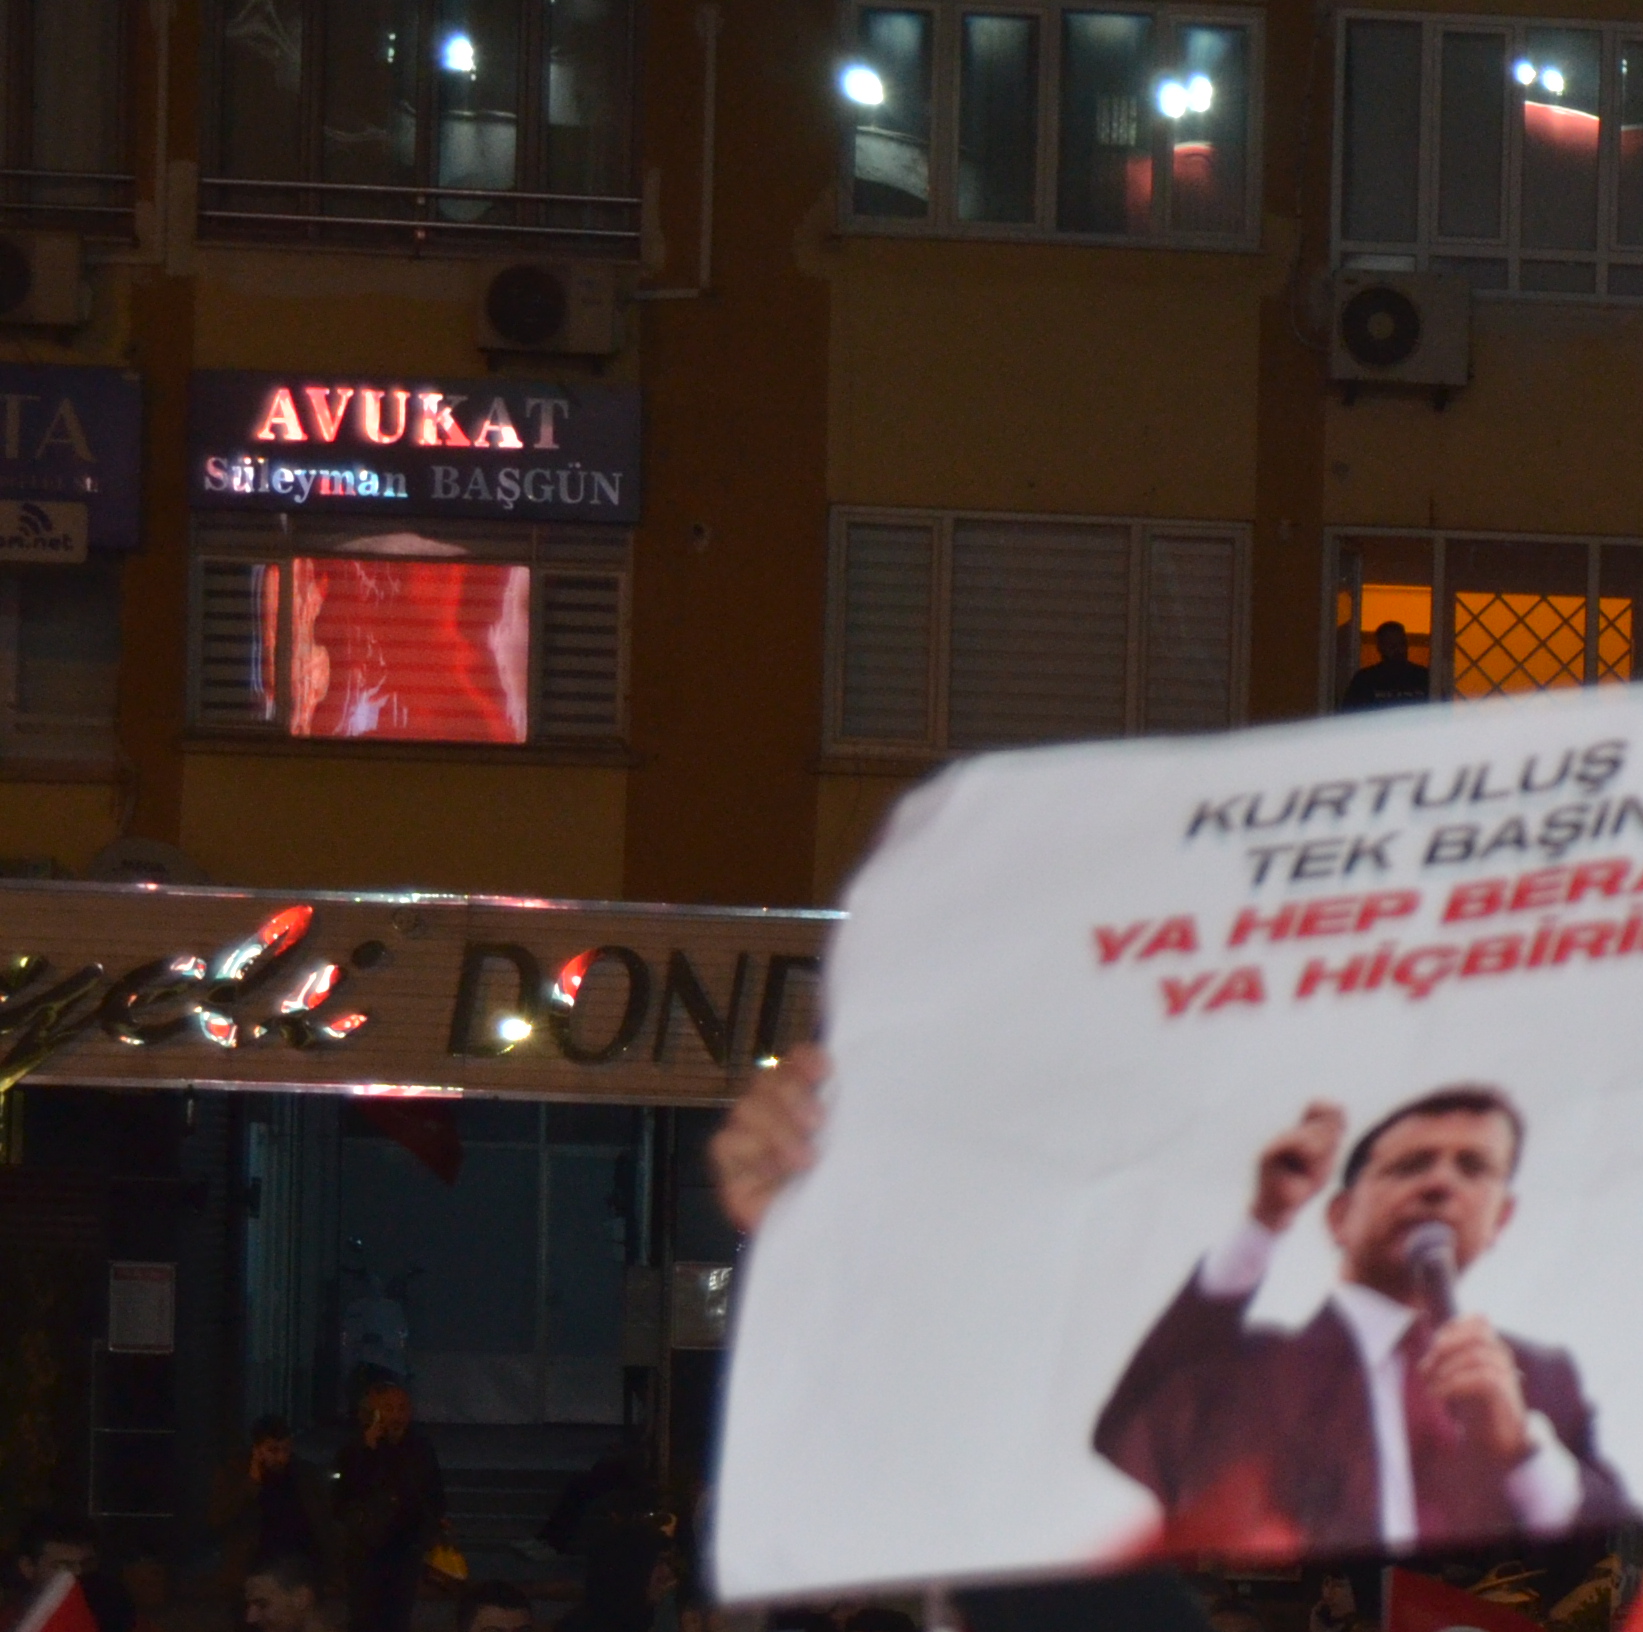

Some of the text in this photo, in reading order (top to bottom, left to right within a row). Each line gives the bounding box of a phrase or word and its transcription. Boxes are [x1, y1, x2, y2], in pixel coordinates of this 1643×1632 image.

[257, 386, 570, 450] AVUKAT
[203, 455, 624, 510] Süleyman BAŞGÜN
[1183, 737, 1631, 840] KURTULUŞ
[1243, 838, 1396, 889] TEK
[1088, 920, 1203, 970] YA
[1225, 889, 1422, 955] HEP
[1154, 965, 1268, 1022] YA
